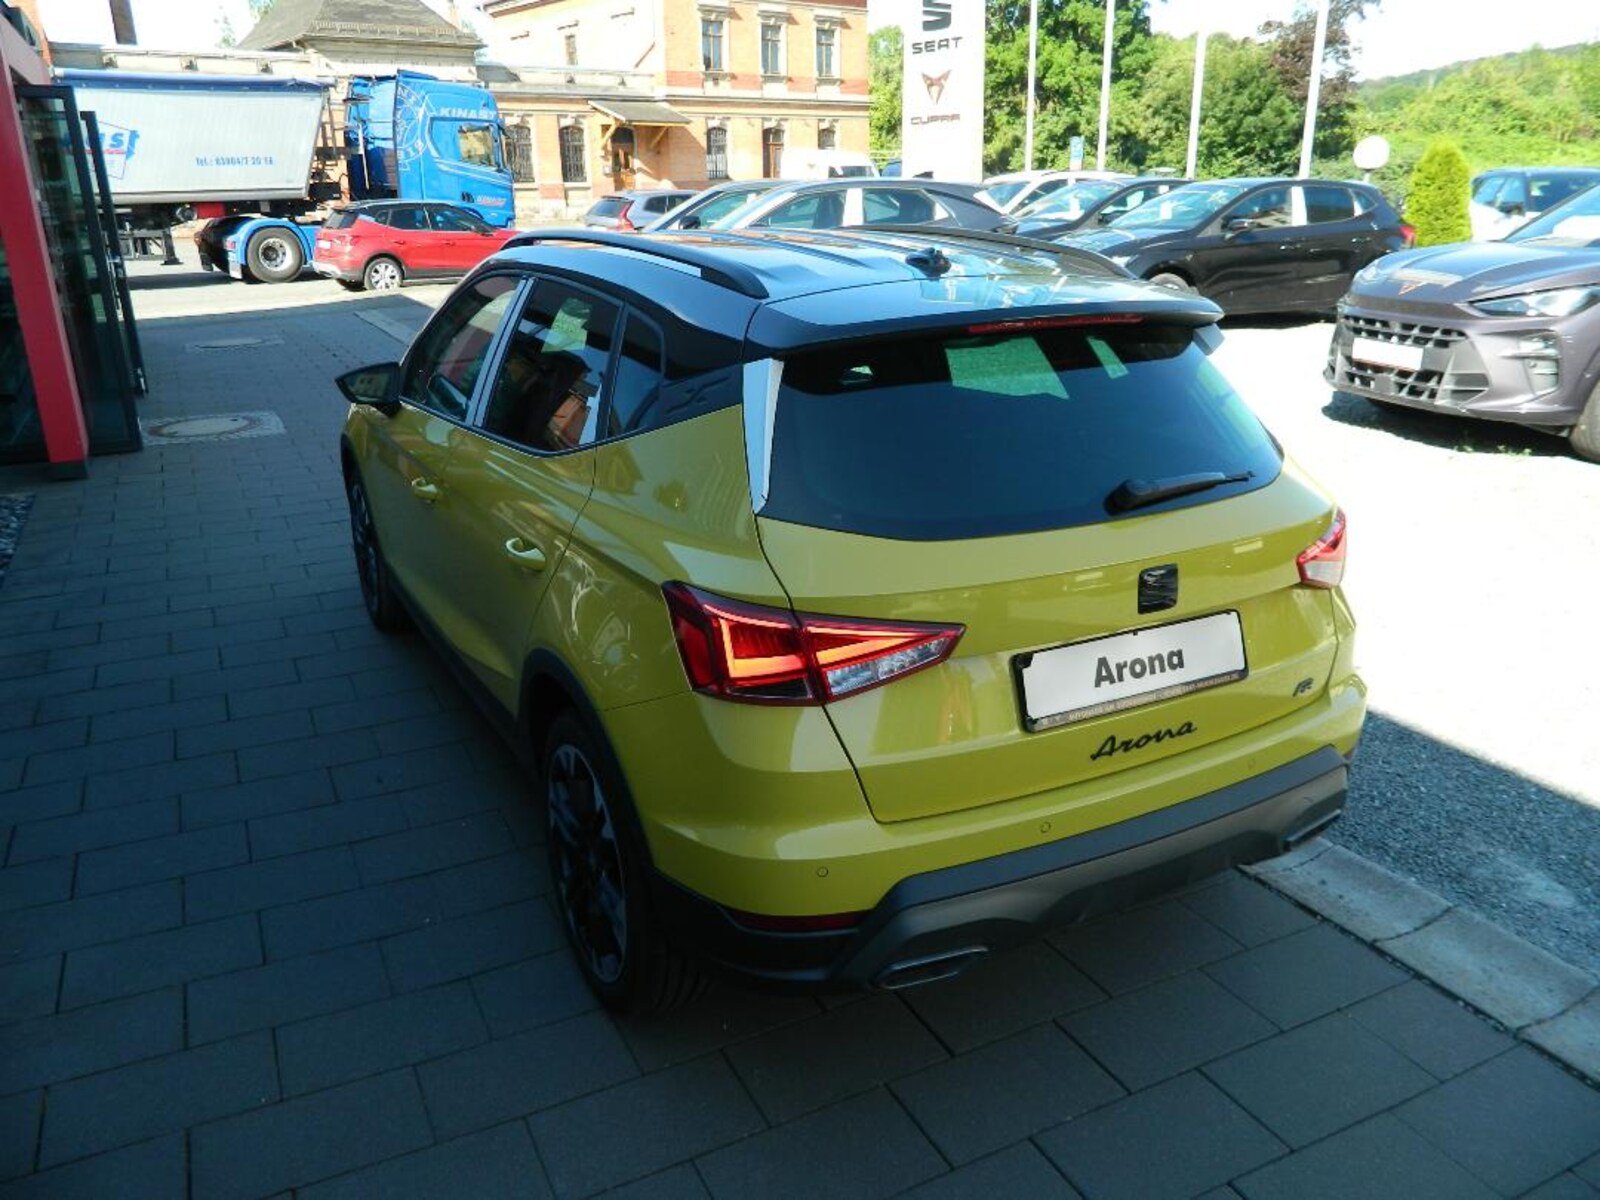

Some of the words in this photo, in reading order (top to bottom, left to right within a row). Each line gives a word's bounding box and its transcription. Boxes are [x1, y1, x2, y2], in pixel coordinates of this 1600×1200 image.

[911, 36, 963, 55] SEAT
[910, 113, 961, 125] CUPRA
[1094, 648, 1185, 688] Arona
[1090, 721, 1197, 761] Arona
